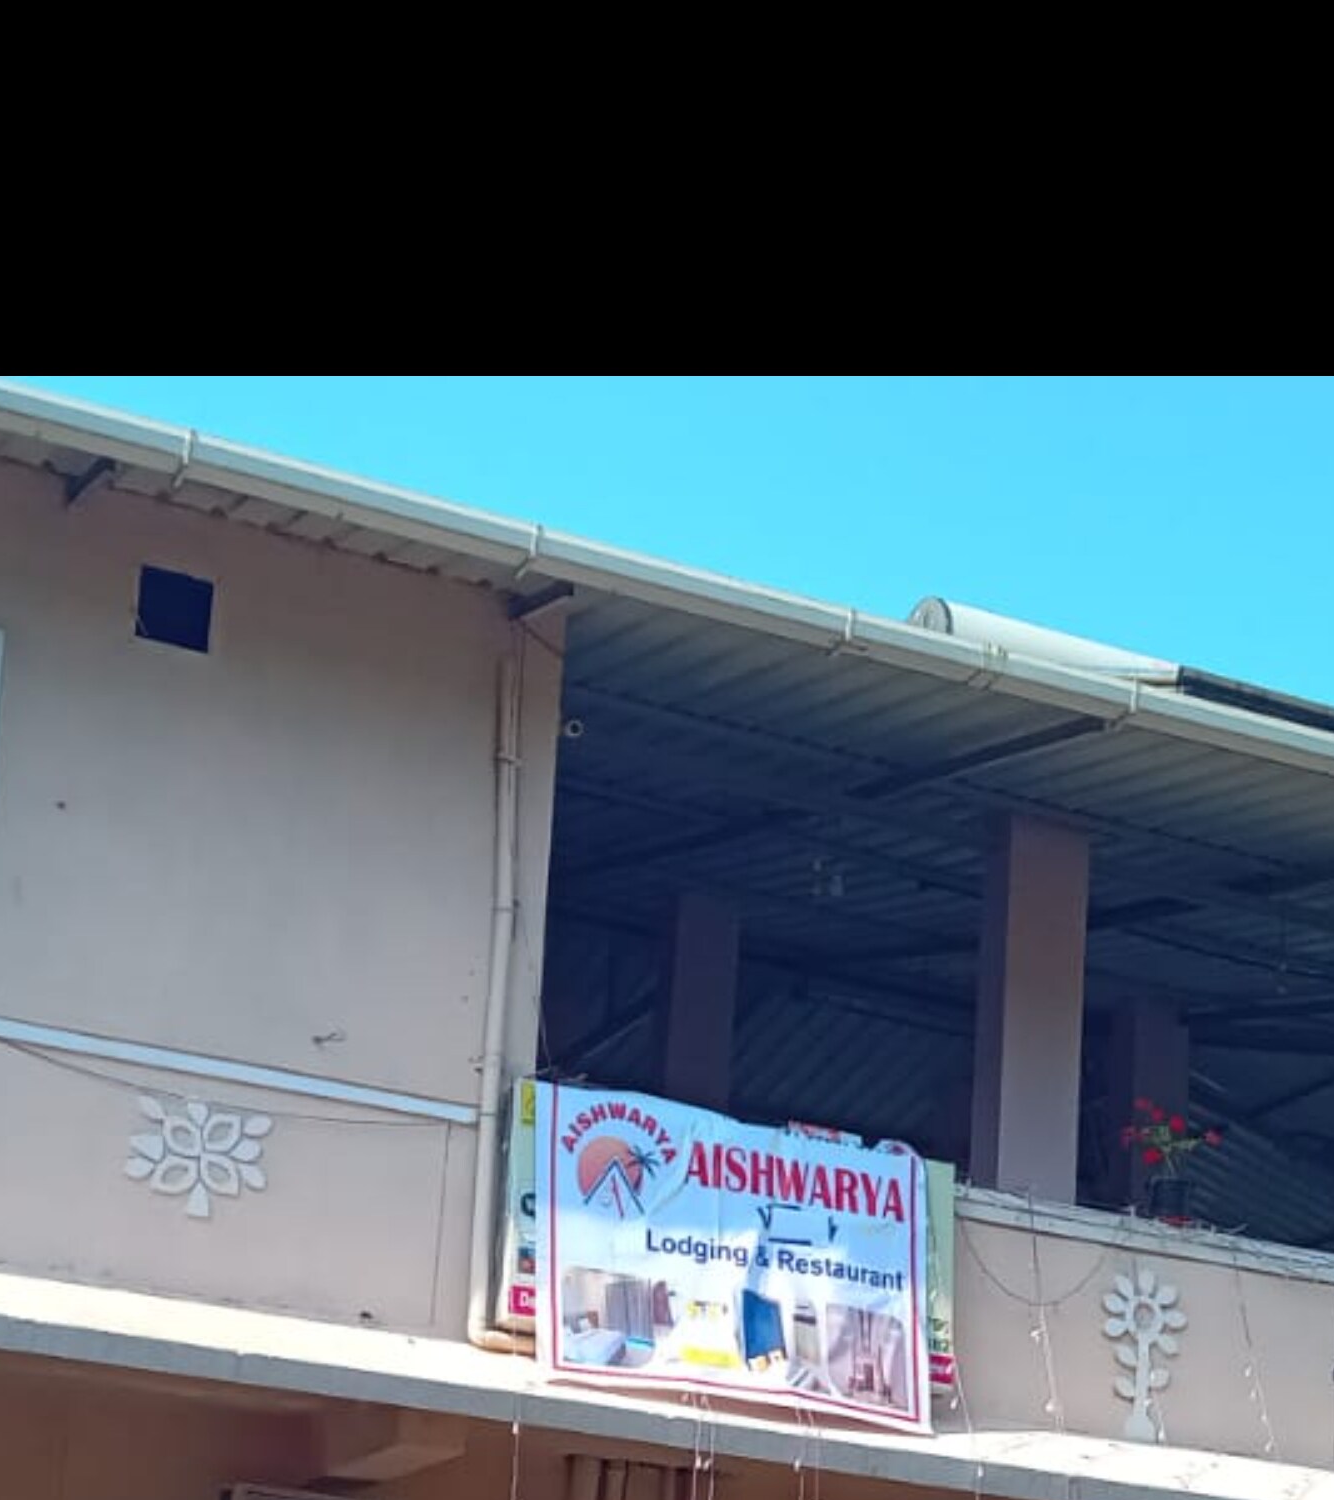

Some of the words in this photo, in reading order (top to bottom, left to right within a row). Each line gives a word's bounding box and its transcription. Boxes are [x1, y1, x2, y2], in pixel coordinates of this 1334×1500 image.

[561, 1102, 676, 1163] AISHWARYA
[685, 1141, 905, 1223] AISHWARYA
[646, 1228, 748, 1268] Lodging
[755, 1245, 769, 1268] &
[777, 1249, 904, 1292] Restaurant
